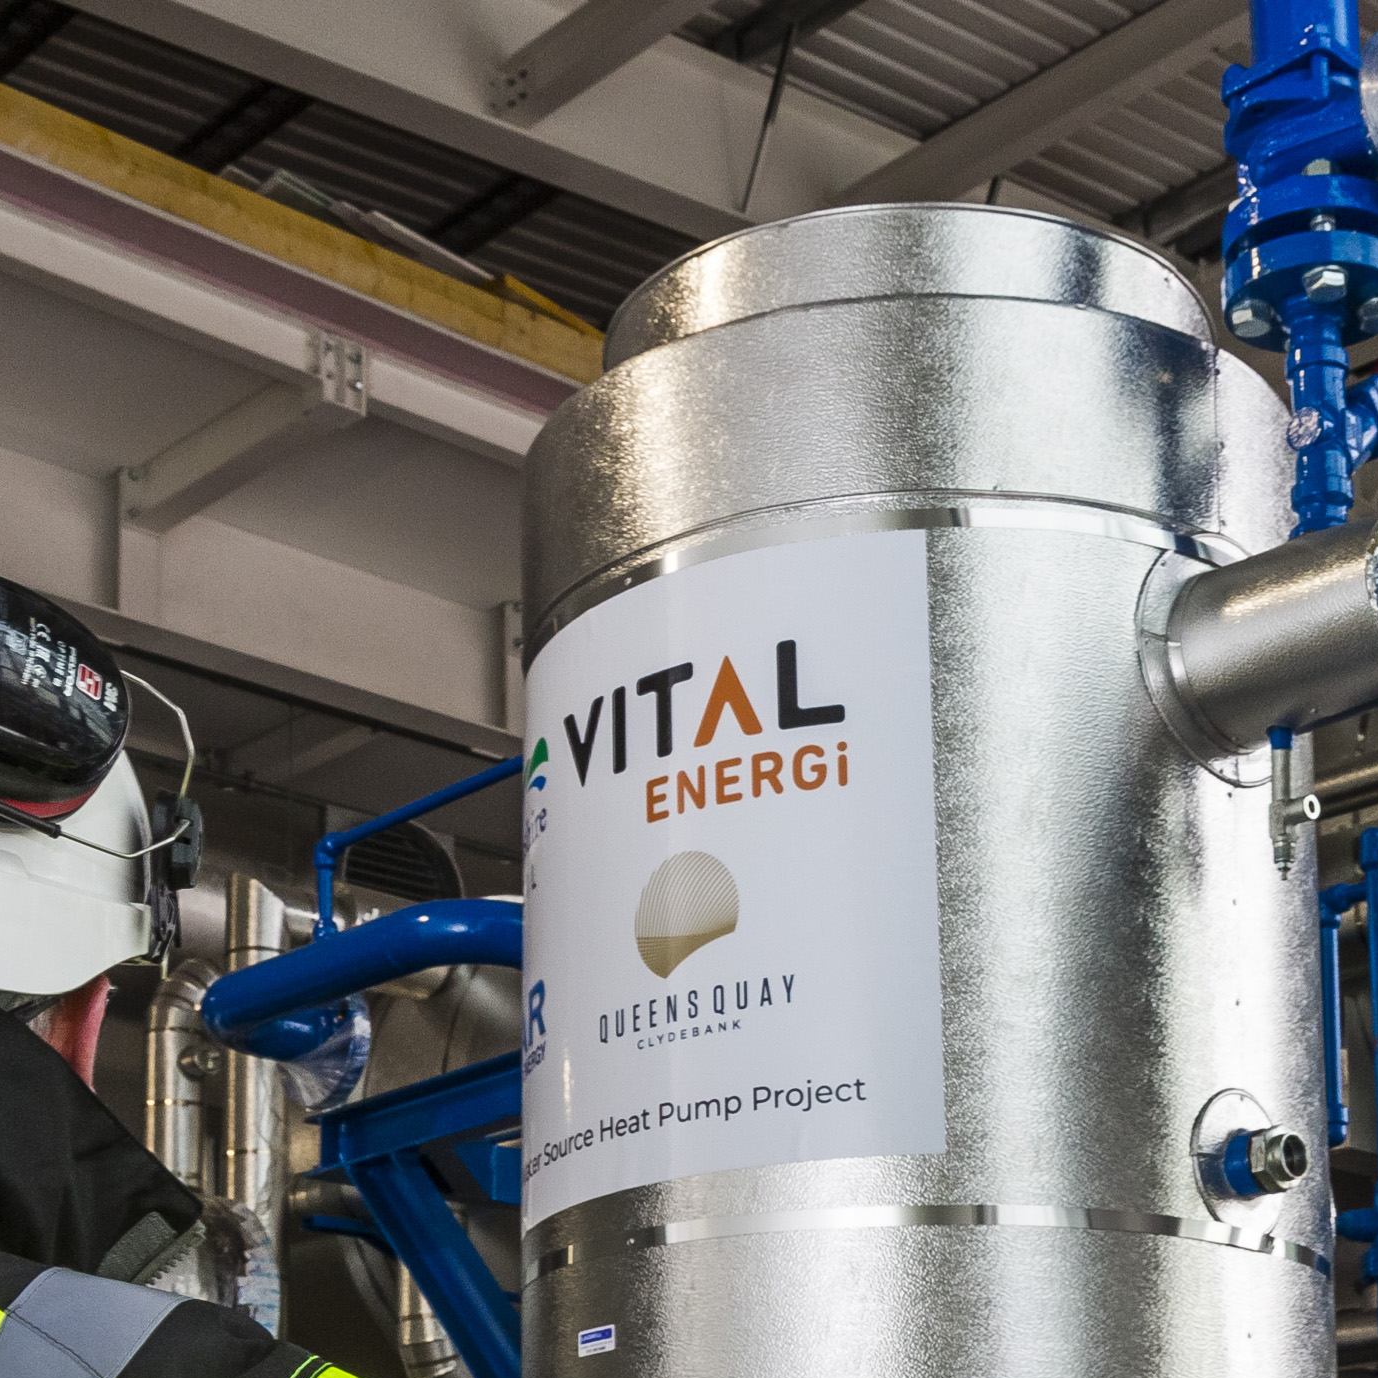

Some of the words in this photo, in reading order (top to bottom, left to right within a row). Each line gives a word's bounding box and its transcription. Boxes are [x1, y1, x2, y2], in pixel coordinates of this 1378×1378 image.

[103, 682, 119, 712] 3M
[563, 639, 845, 788] VITAL
[599, 989, 698, 1044] QUEENS
[713, 974, 795, 1015] QUAY
[636, 1019, 742, 1050] CLYDEBANK
[544, 1129, 594, 1166] Source
[599, 1109, 651, 1143] Heat
[658, 1095, 743, 1127] Pump
[752, 1079, 867, 1112] Project
